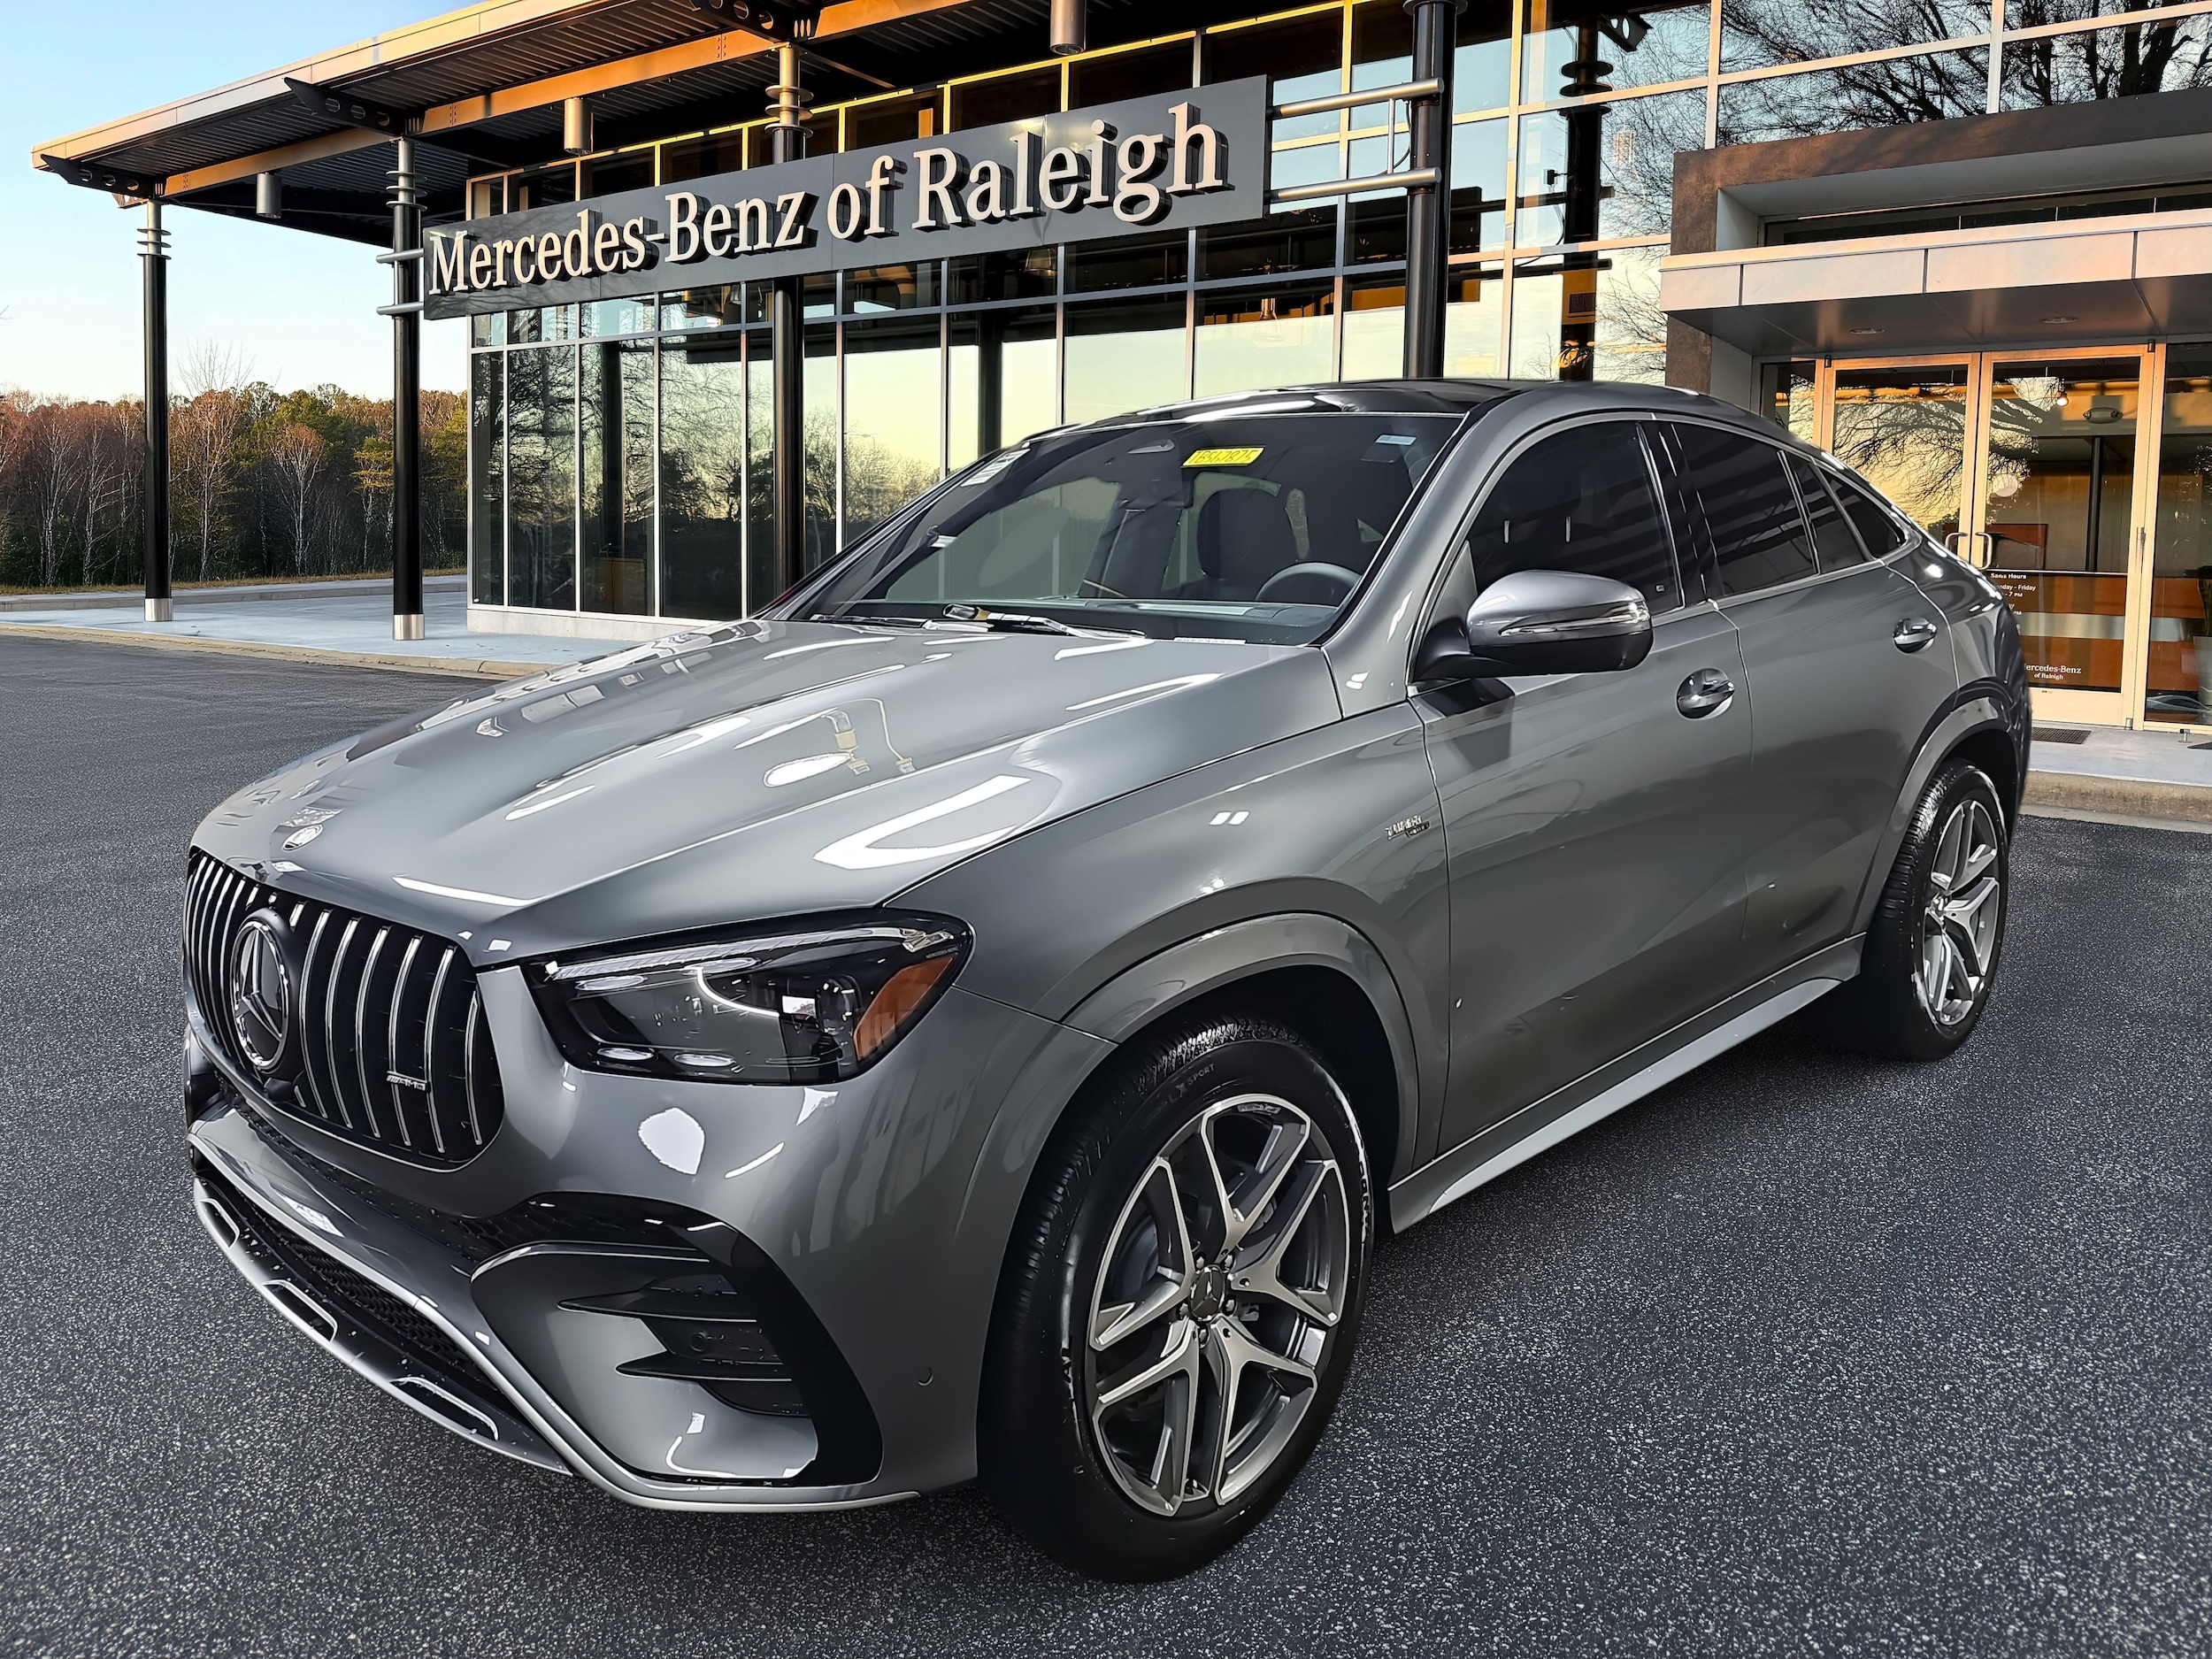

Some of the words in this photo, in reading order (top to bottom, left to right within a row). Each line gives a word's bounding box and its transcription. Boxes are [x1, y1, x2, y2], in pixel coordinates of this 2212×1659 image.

[429, 191, 812, 296] Mercedes-Benz
[827, 155, 897, 241] of
[912, 102, 1226, 223] Raleigh
[2024, 664, 2081, 674] ercedes-Benz
[1187, 1063, 1215, 1086] SPORT
